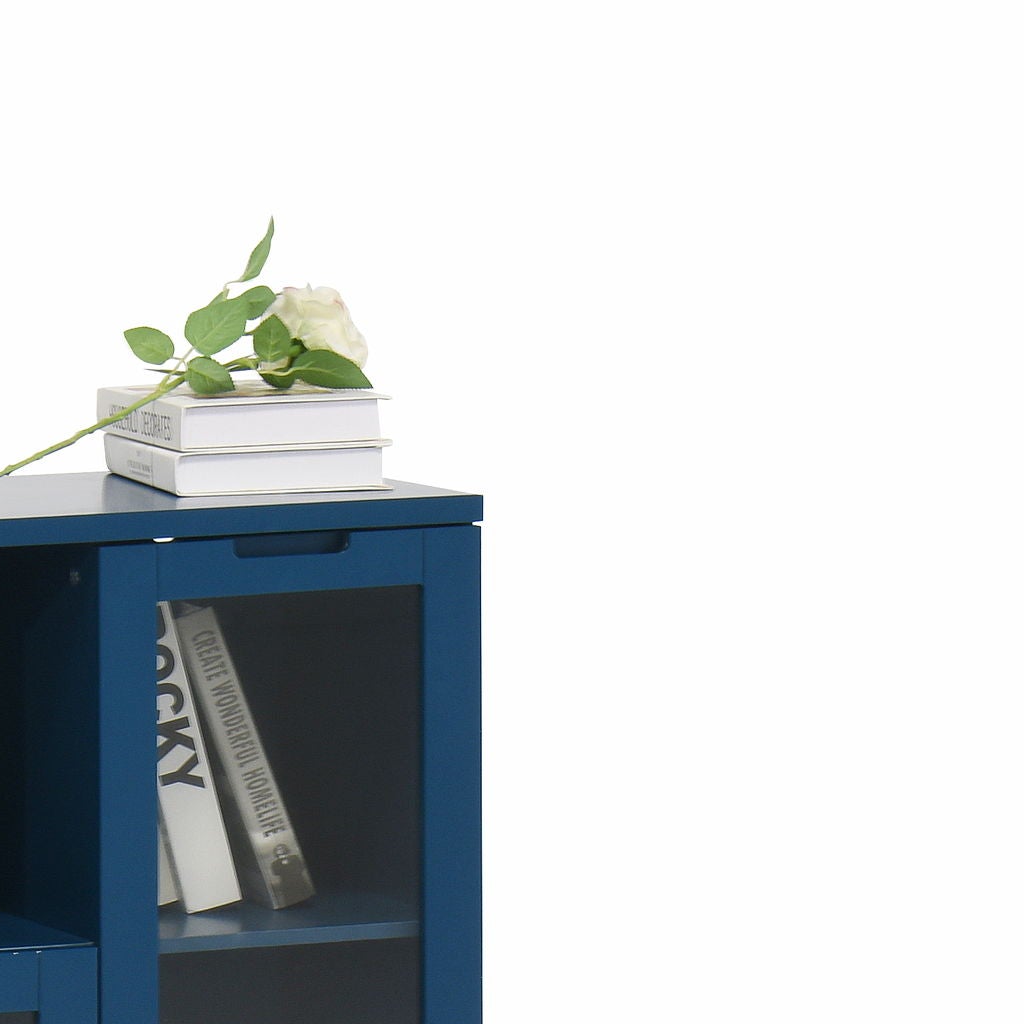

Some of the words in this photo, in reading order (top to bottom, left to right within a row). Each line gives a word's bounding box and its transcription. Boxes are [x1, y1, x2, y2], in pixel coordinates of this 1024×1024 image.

[157, 604, 205, 789] CKY
[192, 630, 228, 681] CREATE
[211, 681, 259, 768] WONDERFUL
[242, 766, 287, 838] HOMELIFE
